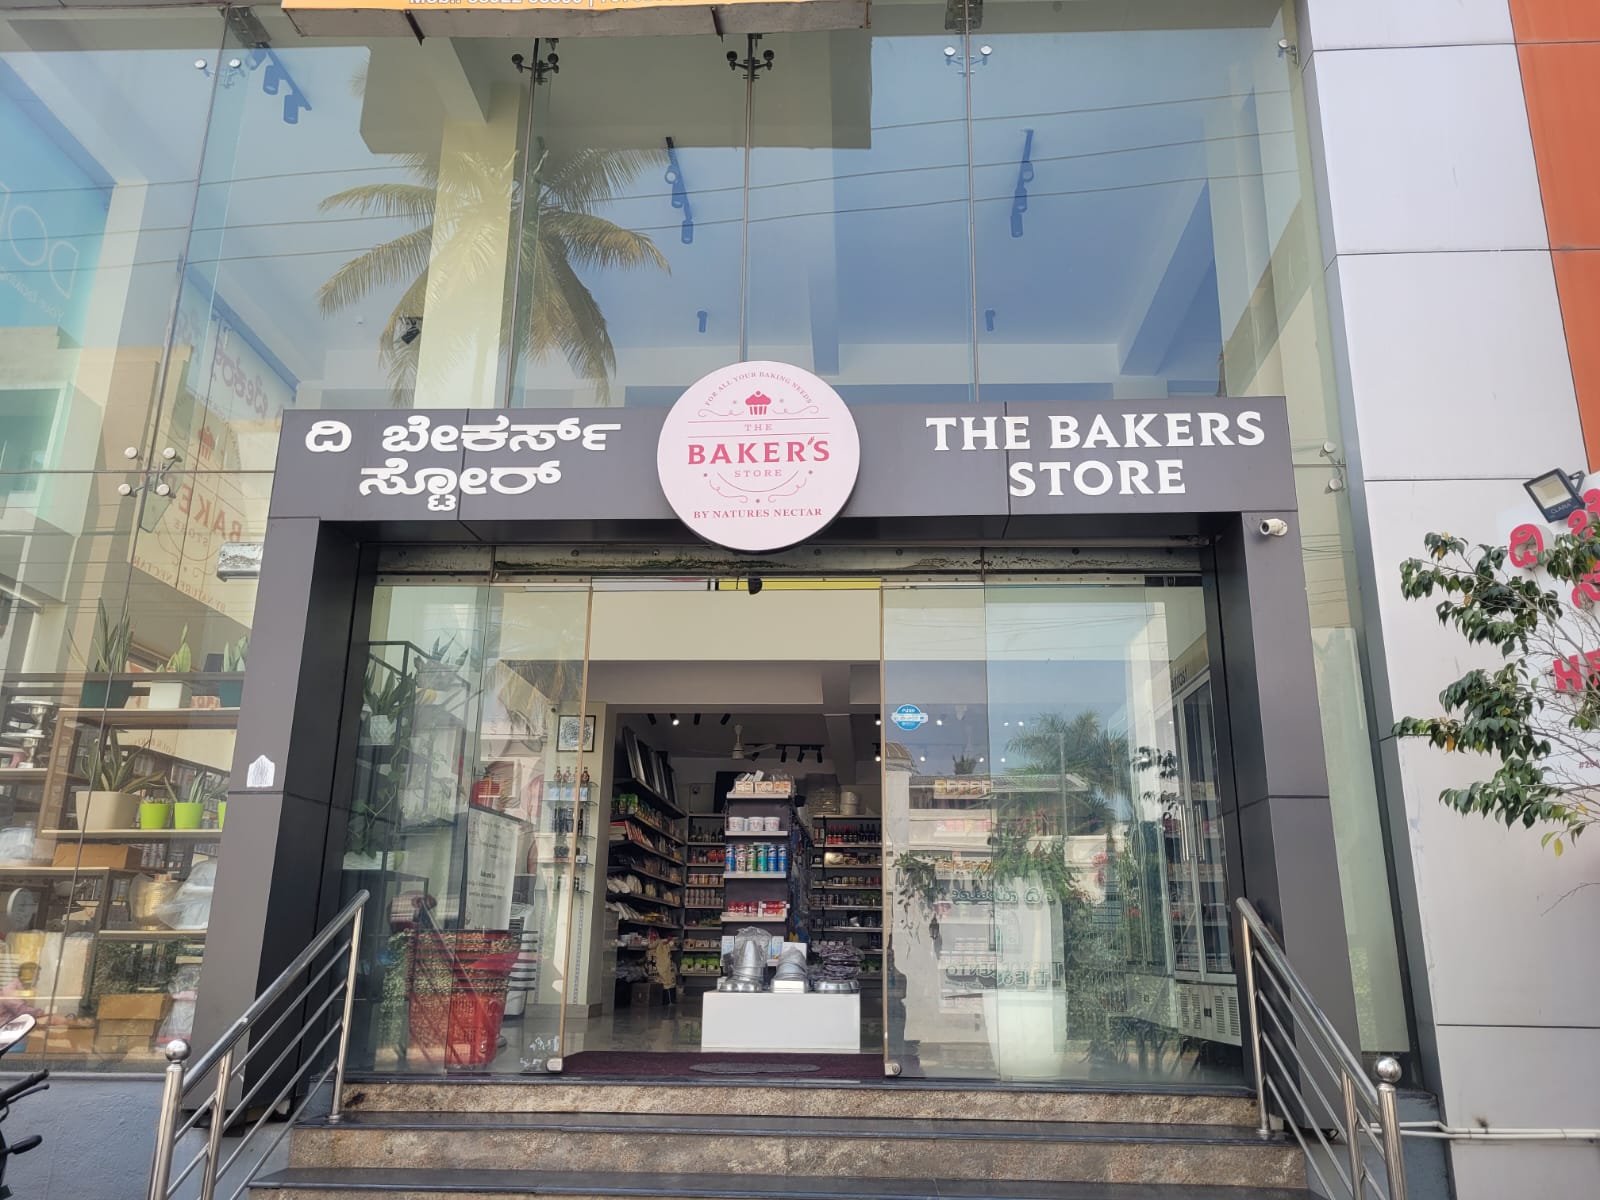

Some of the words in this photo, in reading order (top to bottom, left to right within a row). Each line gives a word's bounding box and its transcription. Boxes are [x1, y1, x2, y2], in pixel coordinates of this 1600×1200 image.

[704, 392, 717, 407] FOR
[718, 379, 733, 392] ALL
[733, 371, 757, 383] YOUR
[759, 371, 791, 385] BAKING
[791, 381, 813, 404] NEEDS
[304, 419, 353, 453] ದಿ
[744, 423, 774, 432] THE
[925, 415, 1030, 451] THE
[1048, 411, 1265, 449] BAKERS
[688, 436, 830, 465] BAKER'S
[734, 469, 783, 478] STORE
[1008, 459, 1187, 497] STORE
[693, 510, 710, 519] BY
[713, 509, 770, 519] NATURES
[774, 507, 823, 518] NECTAR
